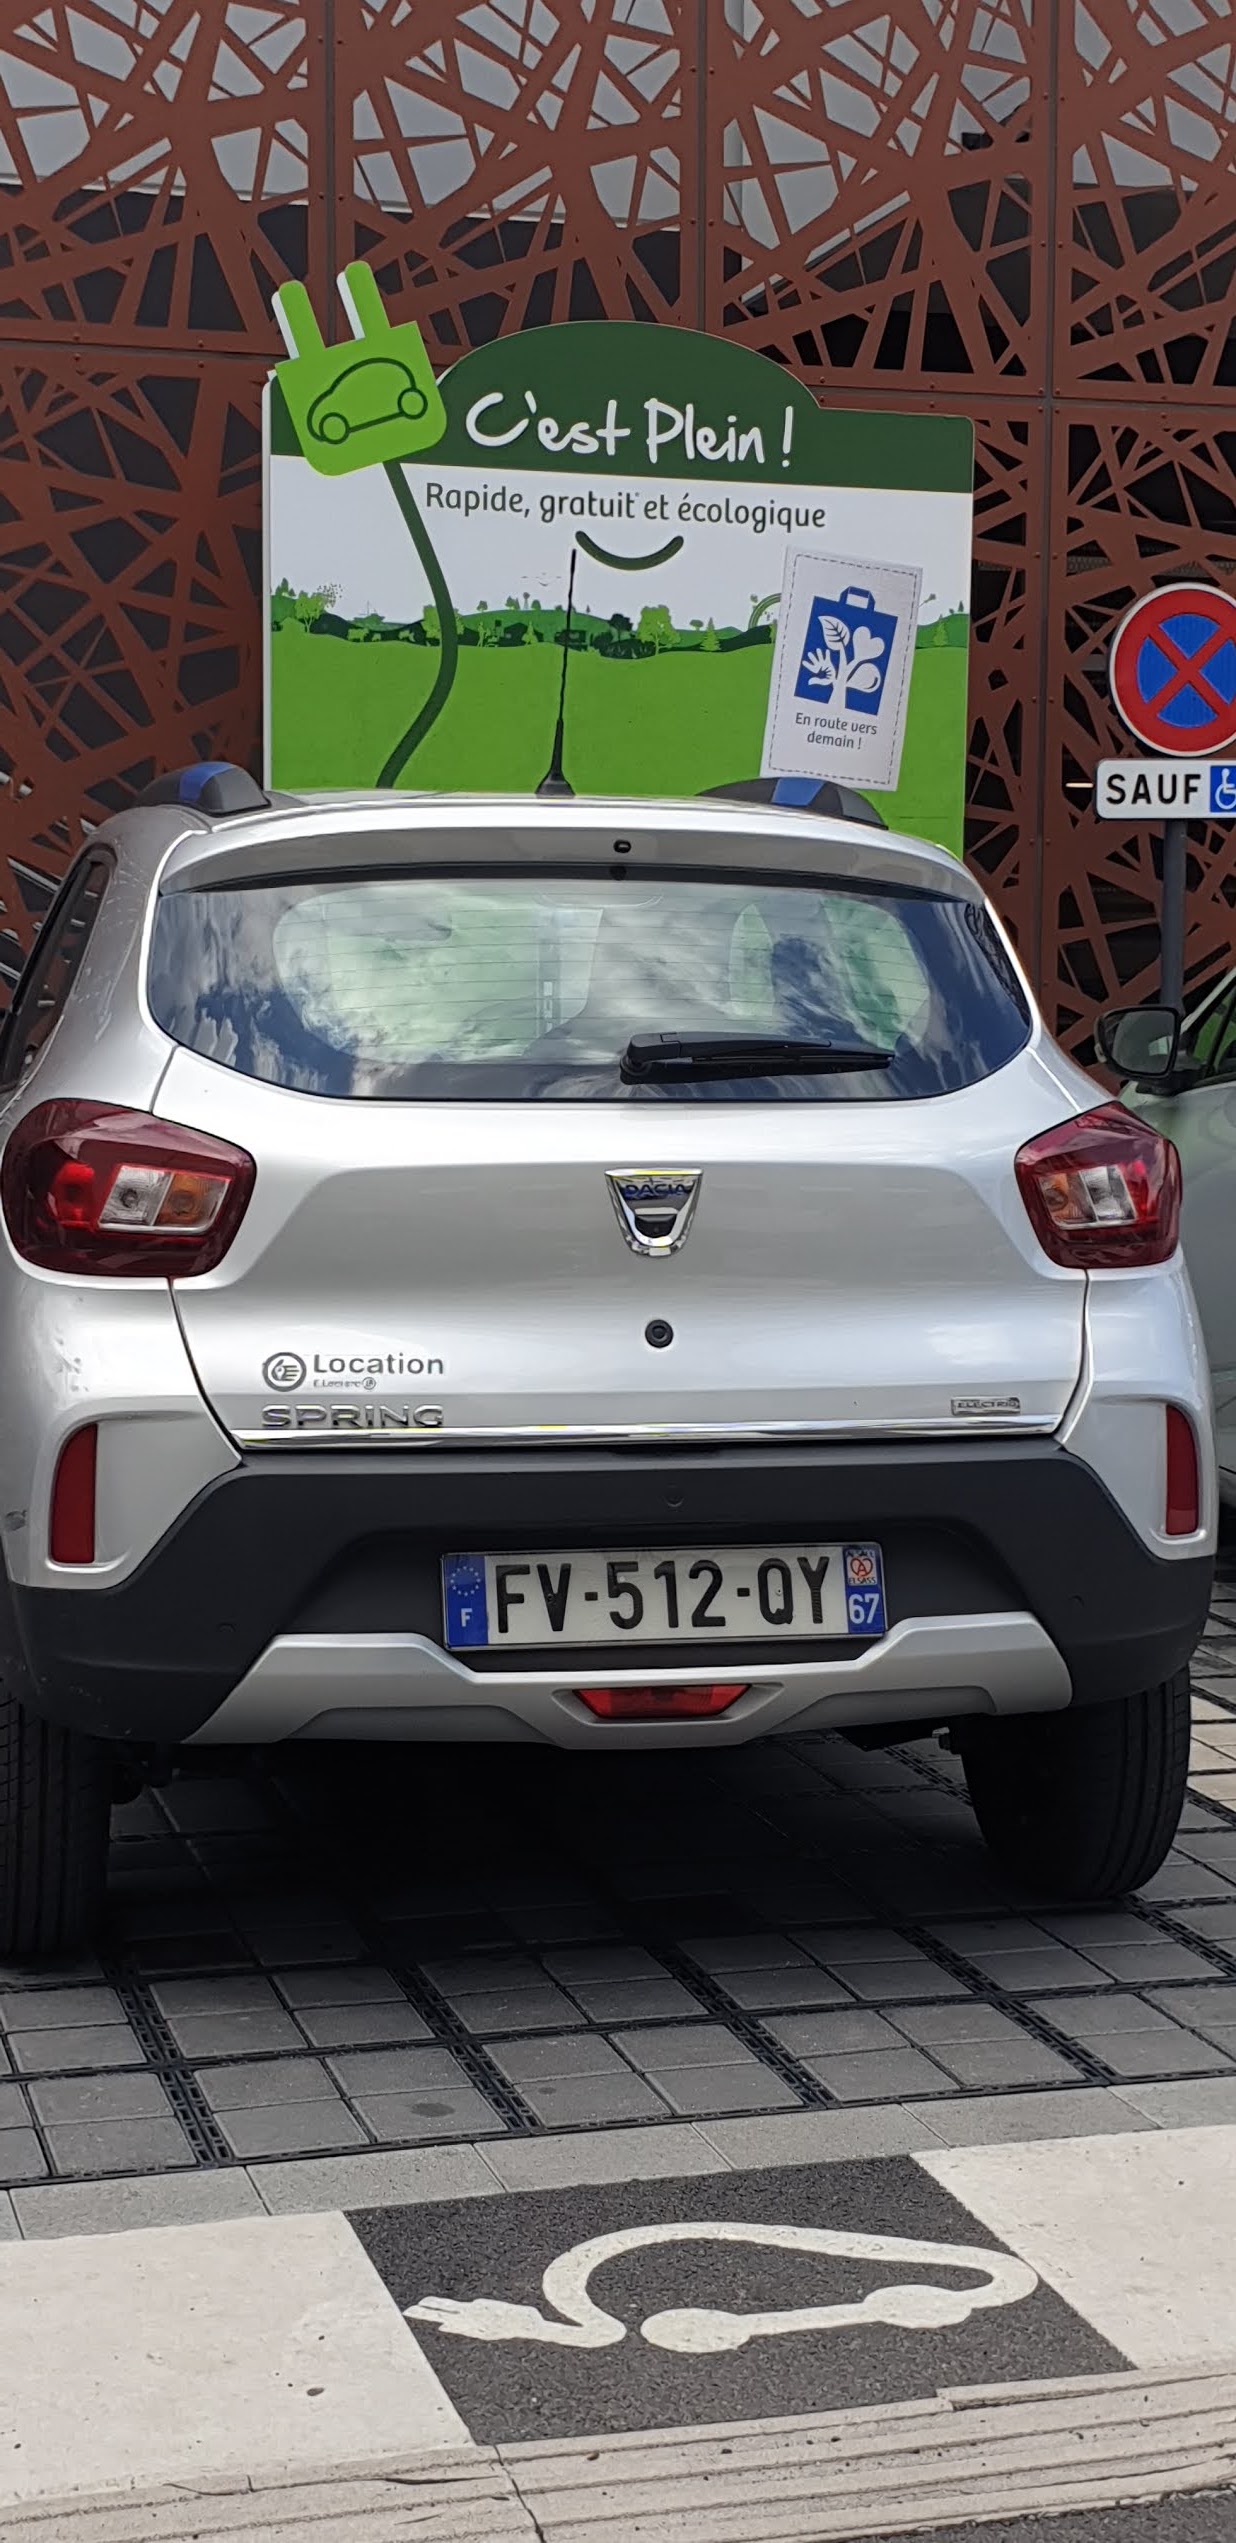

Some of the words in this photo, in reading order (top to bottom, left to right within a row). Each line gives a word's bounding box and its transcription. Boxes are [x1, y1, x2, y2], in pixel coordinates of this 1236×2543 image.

[465, 390, 631, 457] C'est
[644, 397, 765, 464] Plein
[425, 482, 530, 519] Rapide,
[643, 494, 669, 520] et
[677, 493, 826, 534] écologique
[795, 712, 811, 727] En
[814, 716, 848, 731] route
[851, 722, 878, 735] vers
[807, 731, 854, 748] demain
[1106, 774, 1202, 805] SAUF
[623, 1184, 687, 1198] DACIA
[313, 1352, 444, 1375] Location
[261, 1404, 444, 1428] SPRING
[496, 1556, 830, 1633] FV-512-QY
[461, 1608, 472, 1627] F
[848, 1593, 880, 1625] 67
